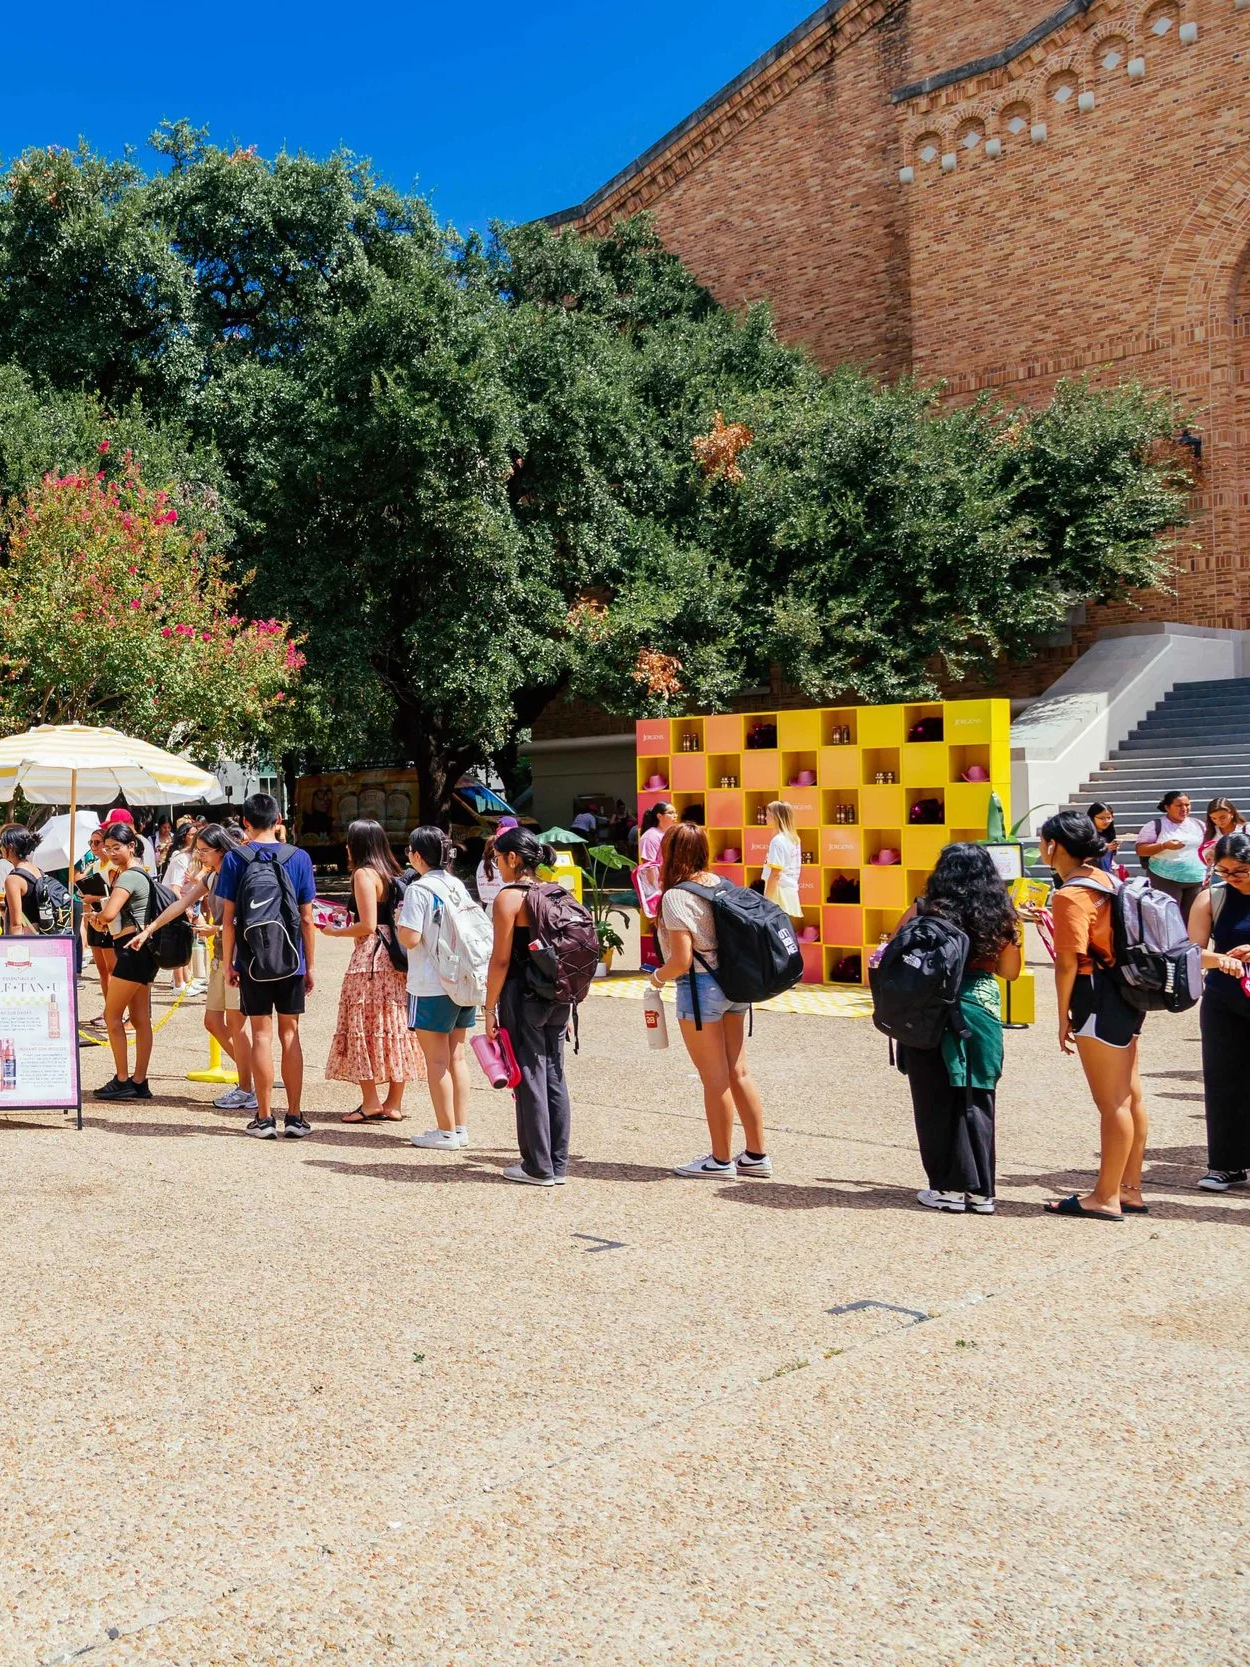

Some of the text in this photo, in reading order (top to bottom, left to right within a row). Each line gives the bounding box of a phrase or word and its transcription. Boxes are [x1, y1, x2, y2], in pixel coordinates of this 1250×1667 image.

[643, 733, 664, 741] JERGENS
[750, 842, 769, 851] JERGE
[828, 843, 854, 851] JERGENS
[18, 983, 47, 993] TAN
[52, 983, 60, 993] U
